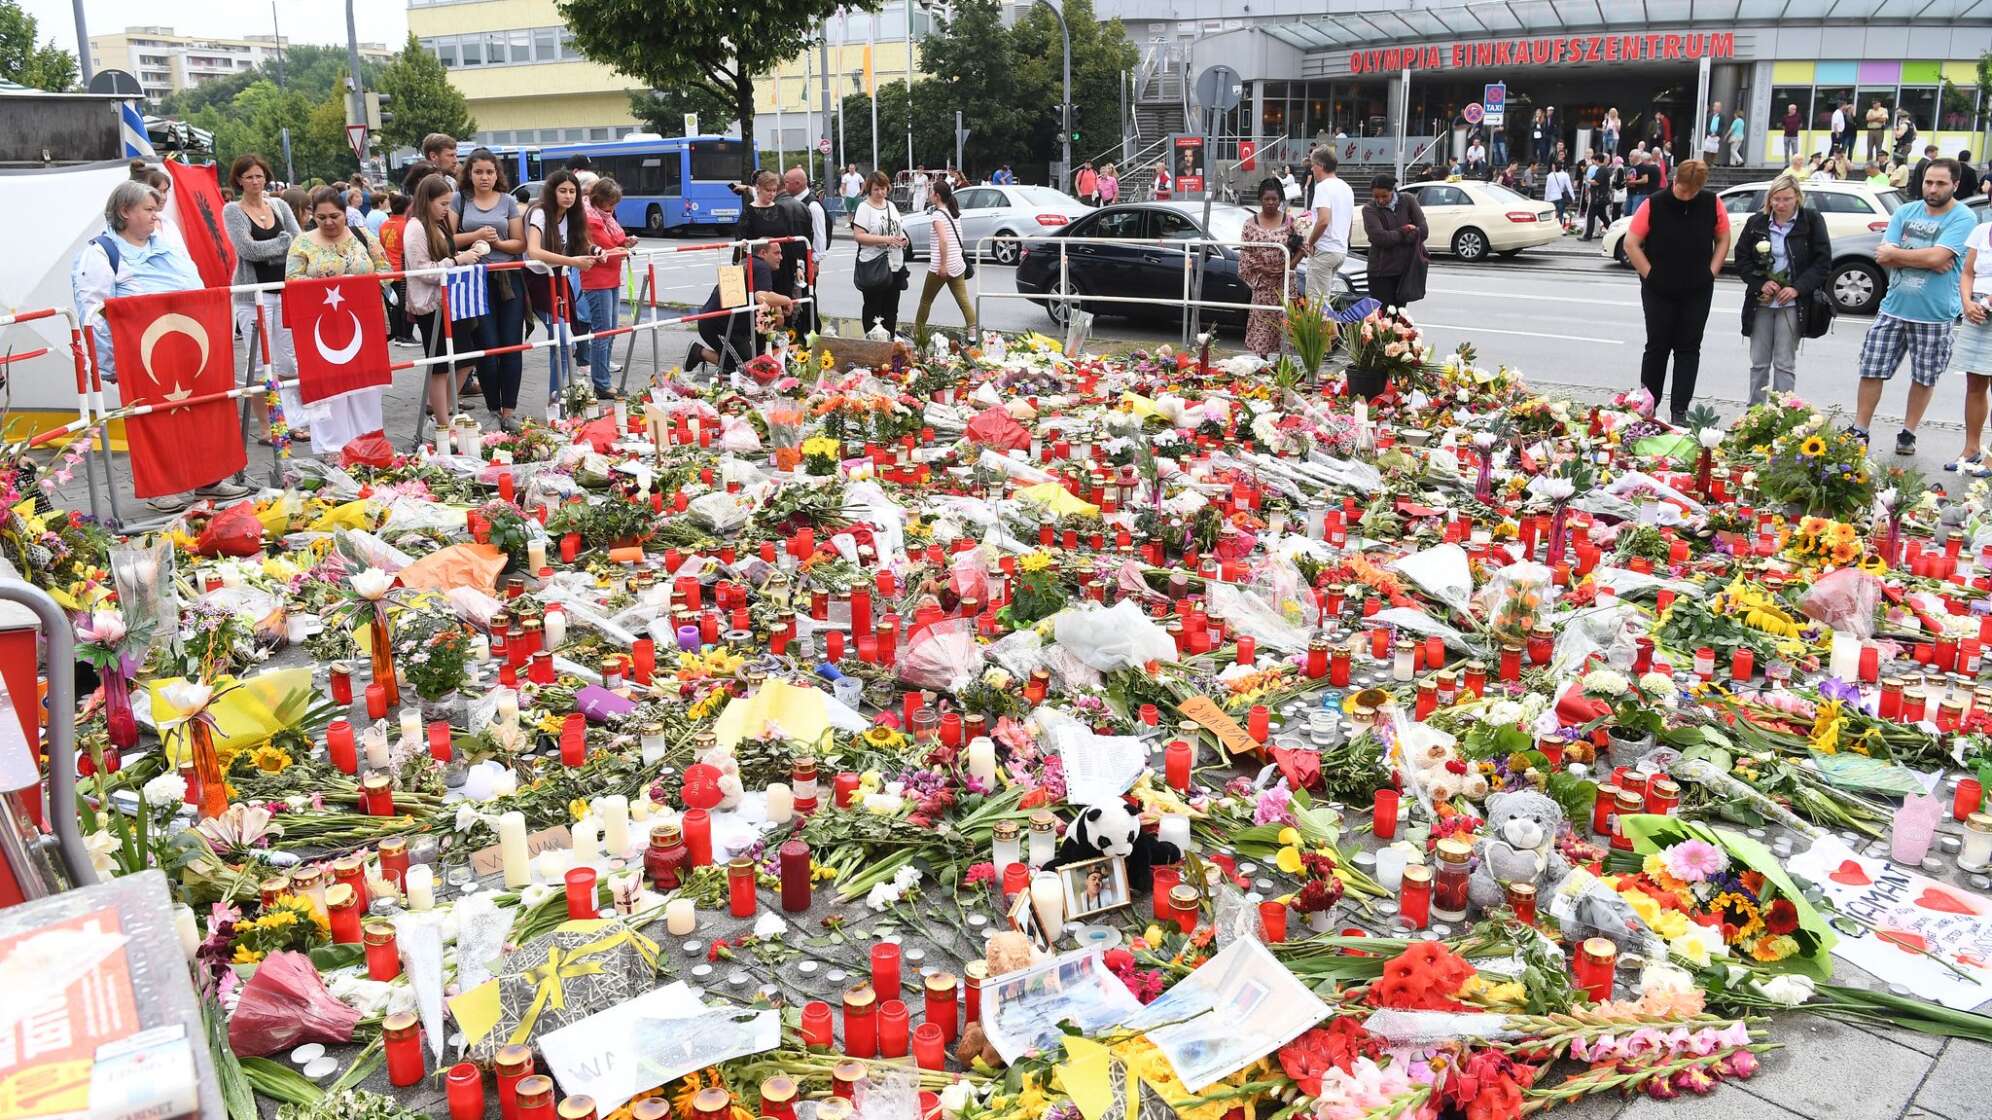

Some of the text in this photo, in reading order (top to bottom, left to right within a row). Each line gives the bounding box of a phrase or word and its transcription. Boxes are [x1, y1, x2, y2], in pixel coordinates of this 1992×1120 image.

[1350, 32, 1736, 74] OLYMPIA EINKAUFSZENTRUM
[1485, 103, 1503, 112] TAXI
